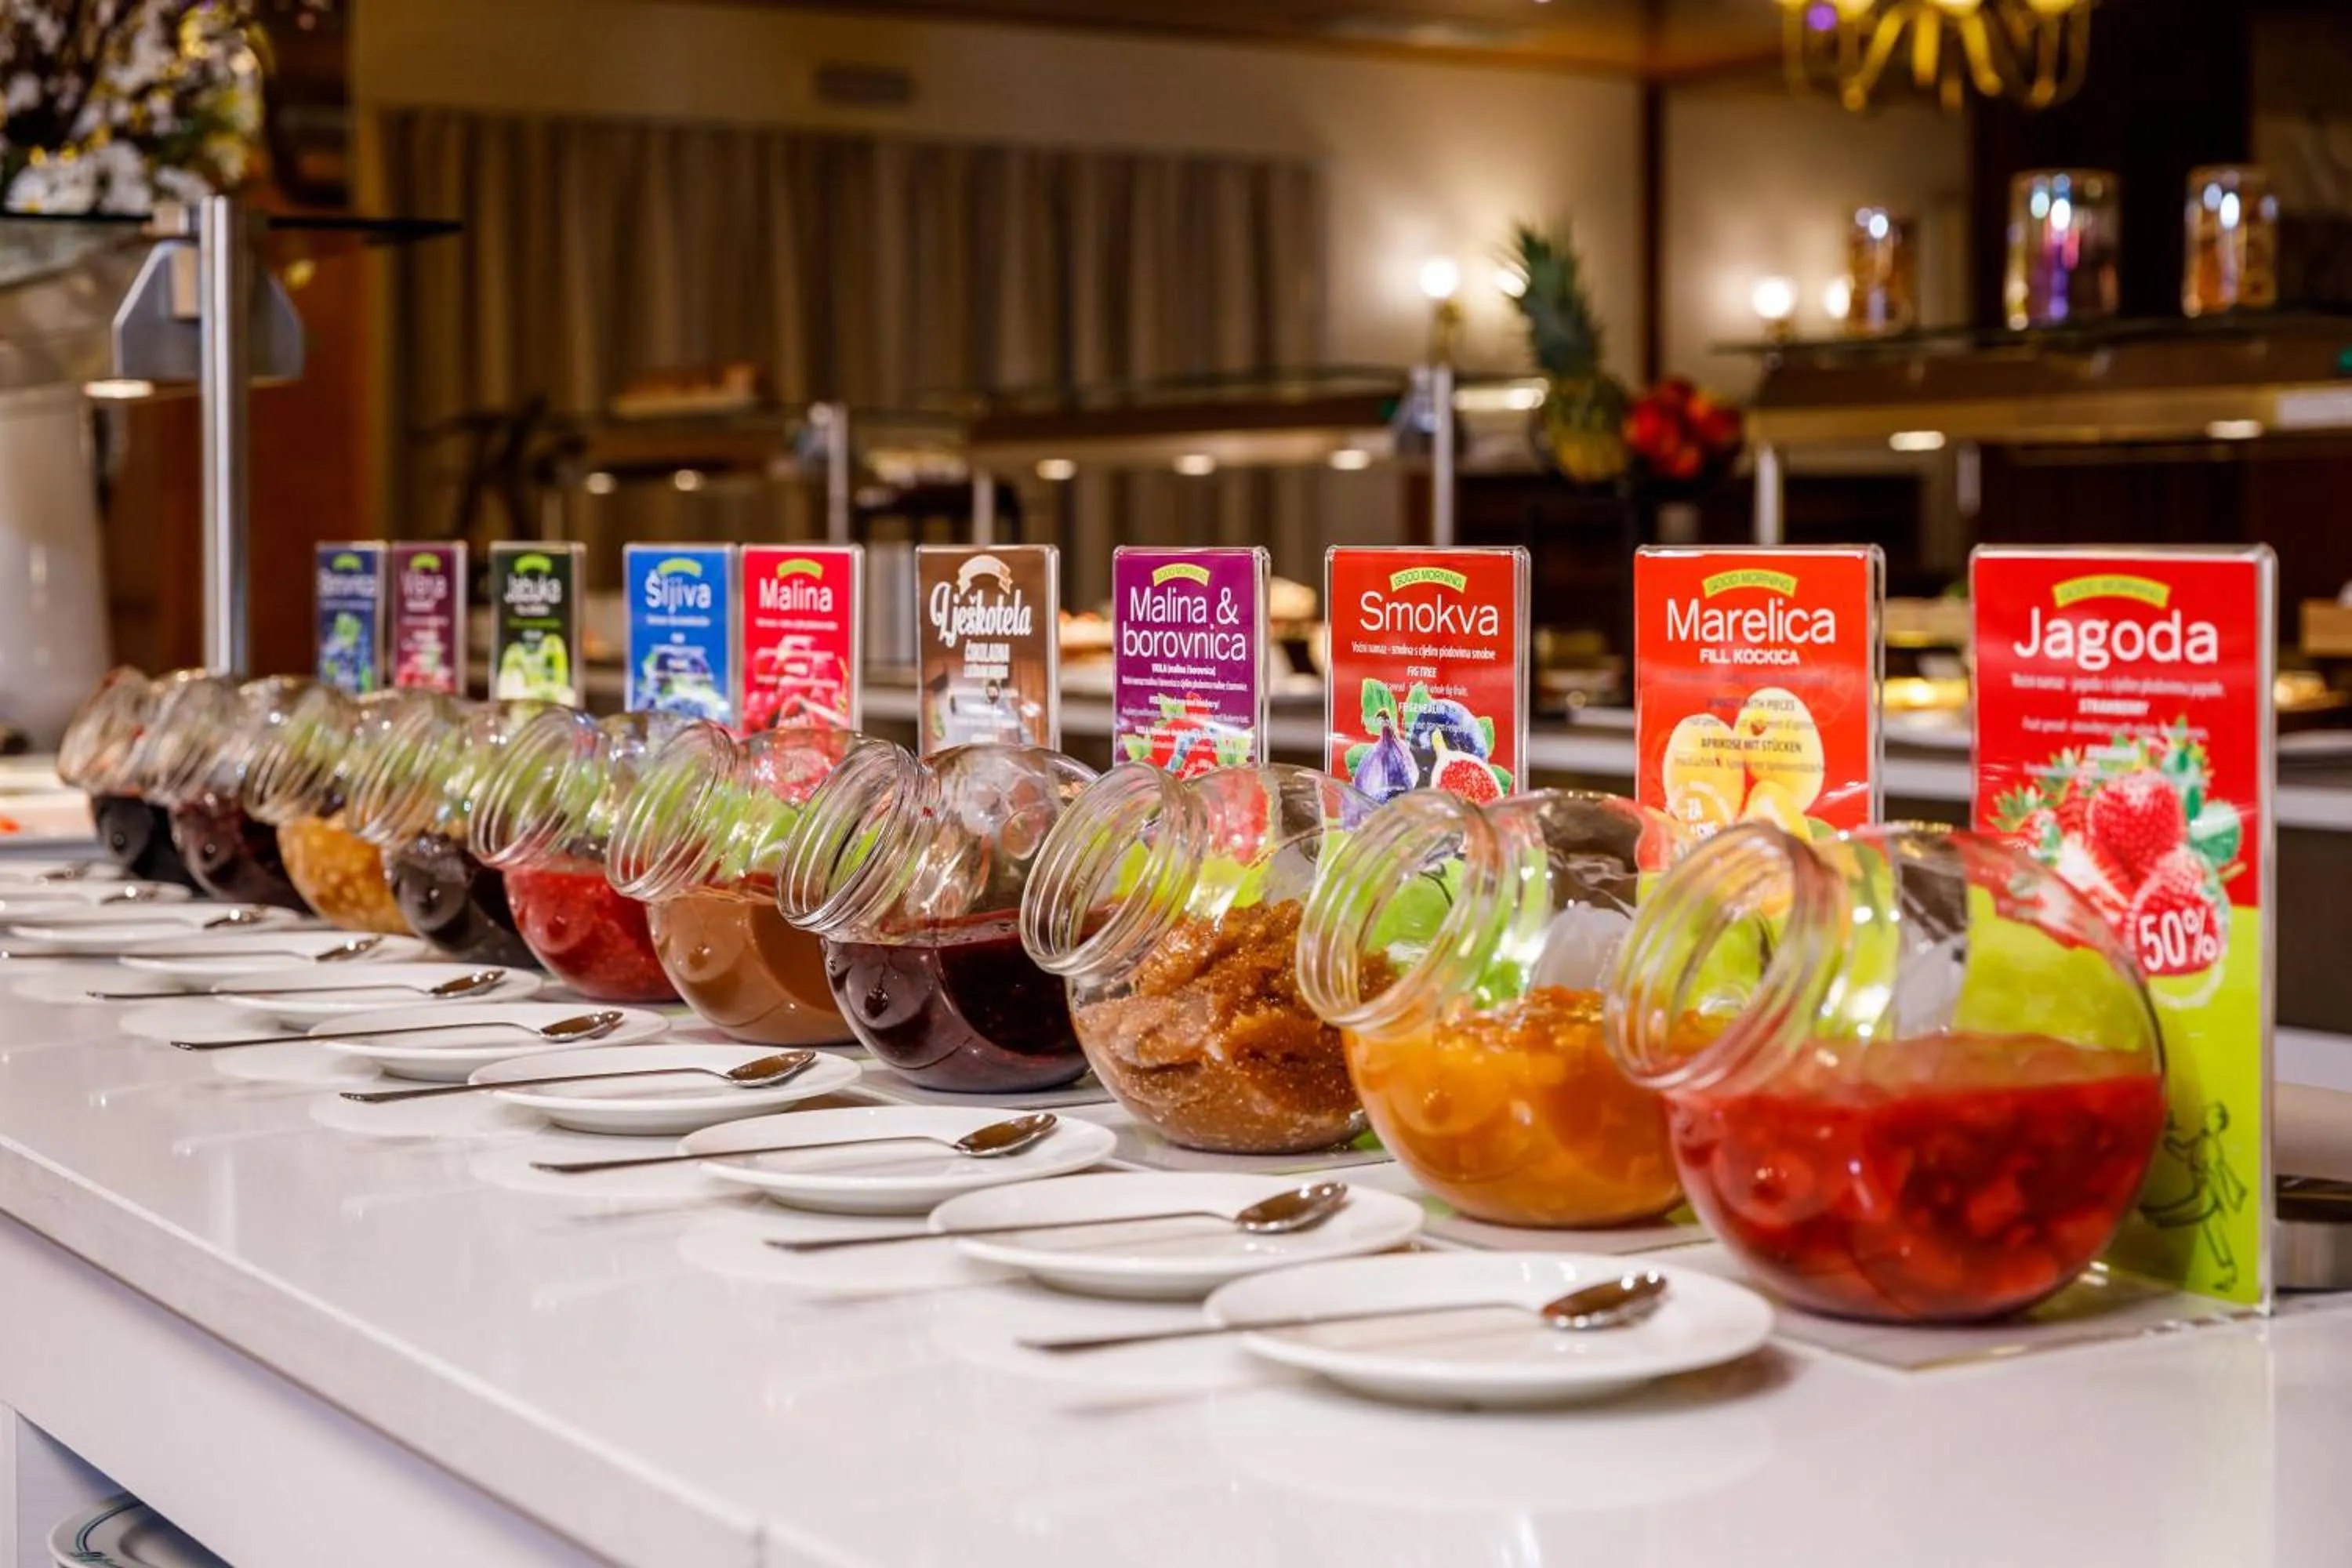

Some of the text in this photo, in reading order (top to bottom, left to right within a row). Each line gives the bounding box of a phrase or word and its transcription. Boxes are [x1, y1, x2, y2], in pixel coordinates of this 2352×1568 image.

[645, 569, 711, 613] Šljiva
[759, 578, 833, 612] Malina
[1395, 570, 1463, 588] GOOD MORNING
[1130, 586, 1240, 625] Malina &
[1359, 590, 1499, 637] Smokva
[1666, 598, 1836, 644] Marelica
[1123, 621, 1247, 661] borovnica
[1699, 648, 1800, 666] FILL KOCKICA
[2013, 606, 2219, 671] Jagoda
[1762, 738, 1802, 753] STÜCKEN
[2139, 906, 2220, 971] 50%
